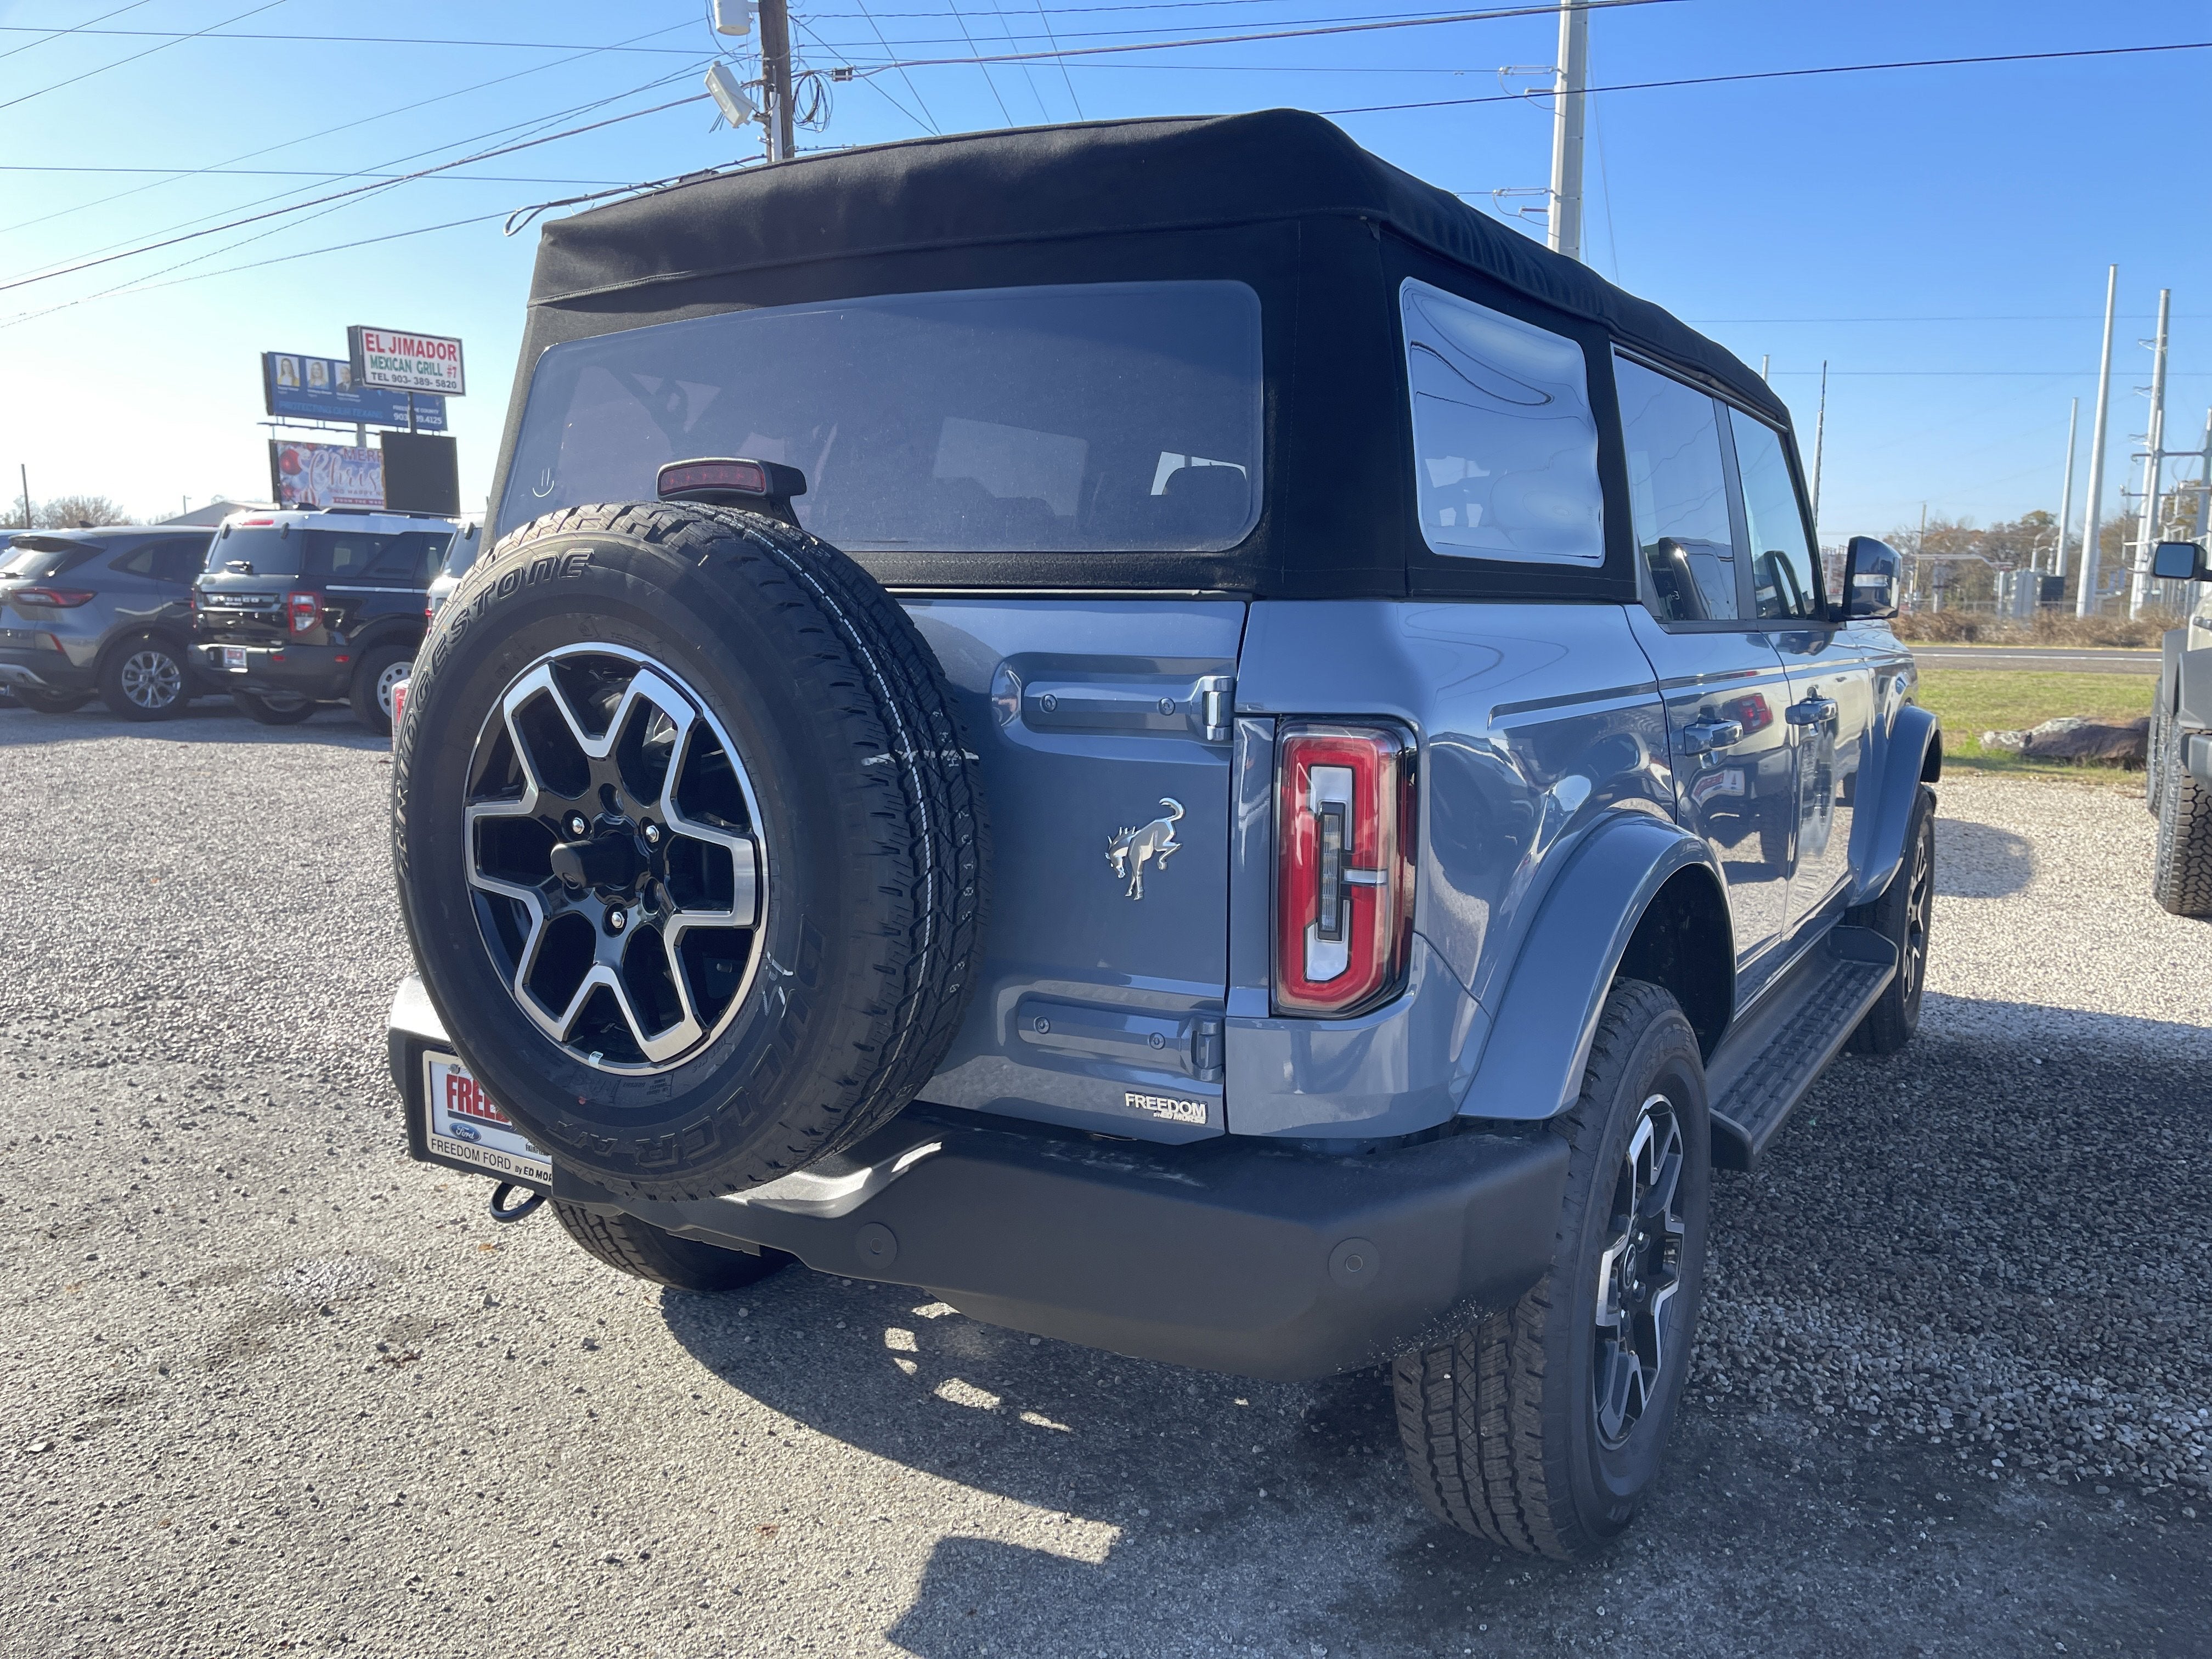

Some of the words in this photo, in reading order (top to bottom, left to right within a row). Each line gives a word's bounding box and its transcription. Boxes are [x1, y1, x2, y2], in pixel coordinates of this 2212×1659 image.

[365, 333, 386, 353] EL
[388, 336, 458, 362] JIMADOR
[370, 354, 411, 373] MEXICAN
[416, 360, 443, 376] GRILL
[447, 364, 457, 379] #7
[371, 372, 390, 381] TEL
[436, 379, 457, 389] 5820
[1125, 1093, 1206, 1117] FREEDOM
[455, 1125, 476, 1140] Ford
[431, 1138, 480, 1162] FREEDOM
[483, 1153, 511, 1170] FORD
[524, 1166, 534, 1177] ED
